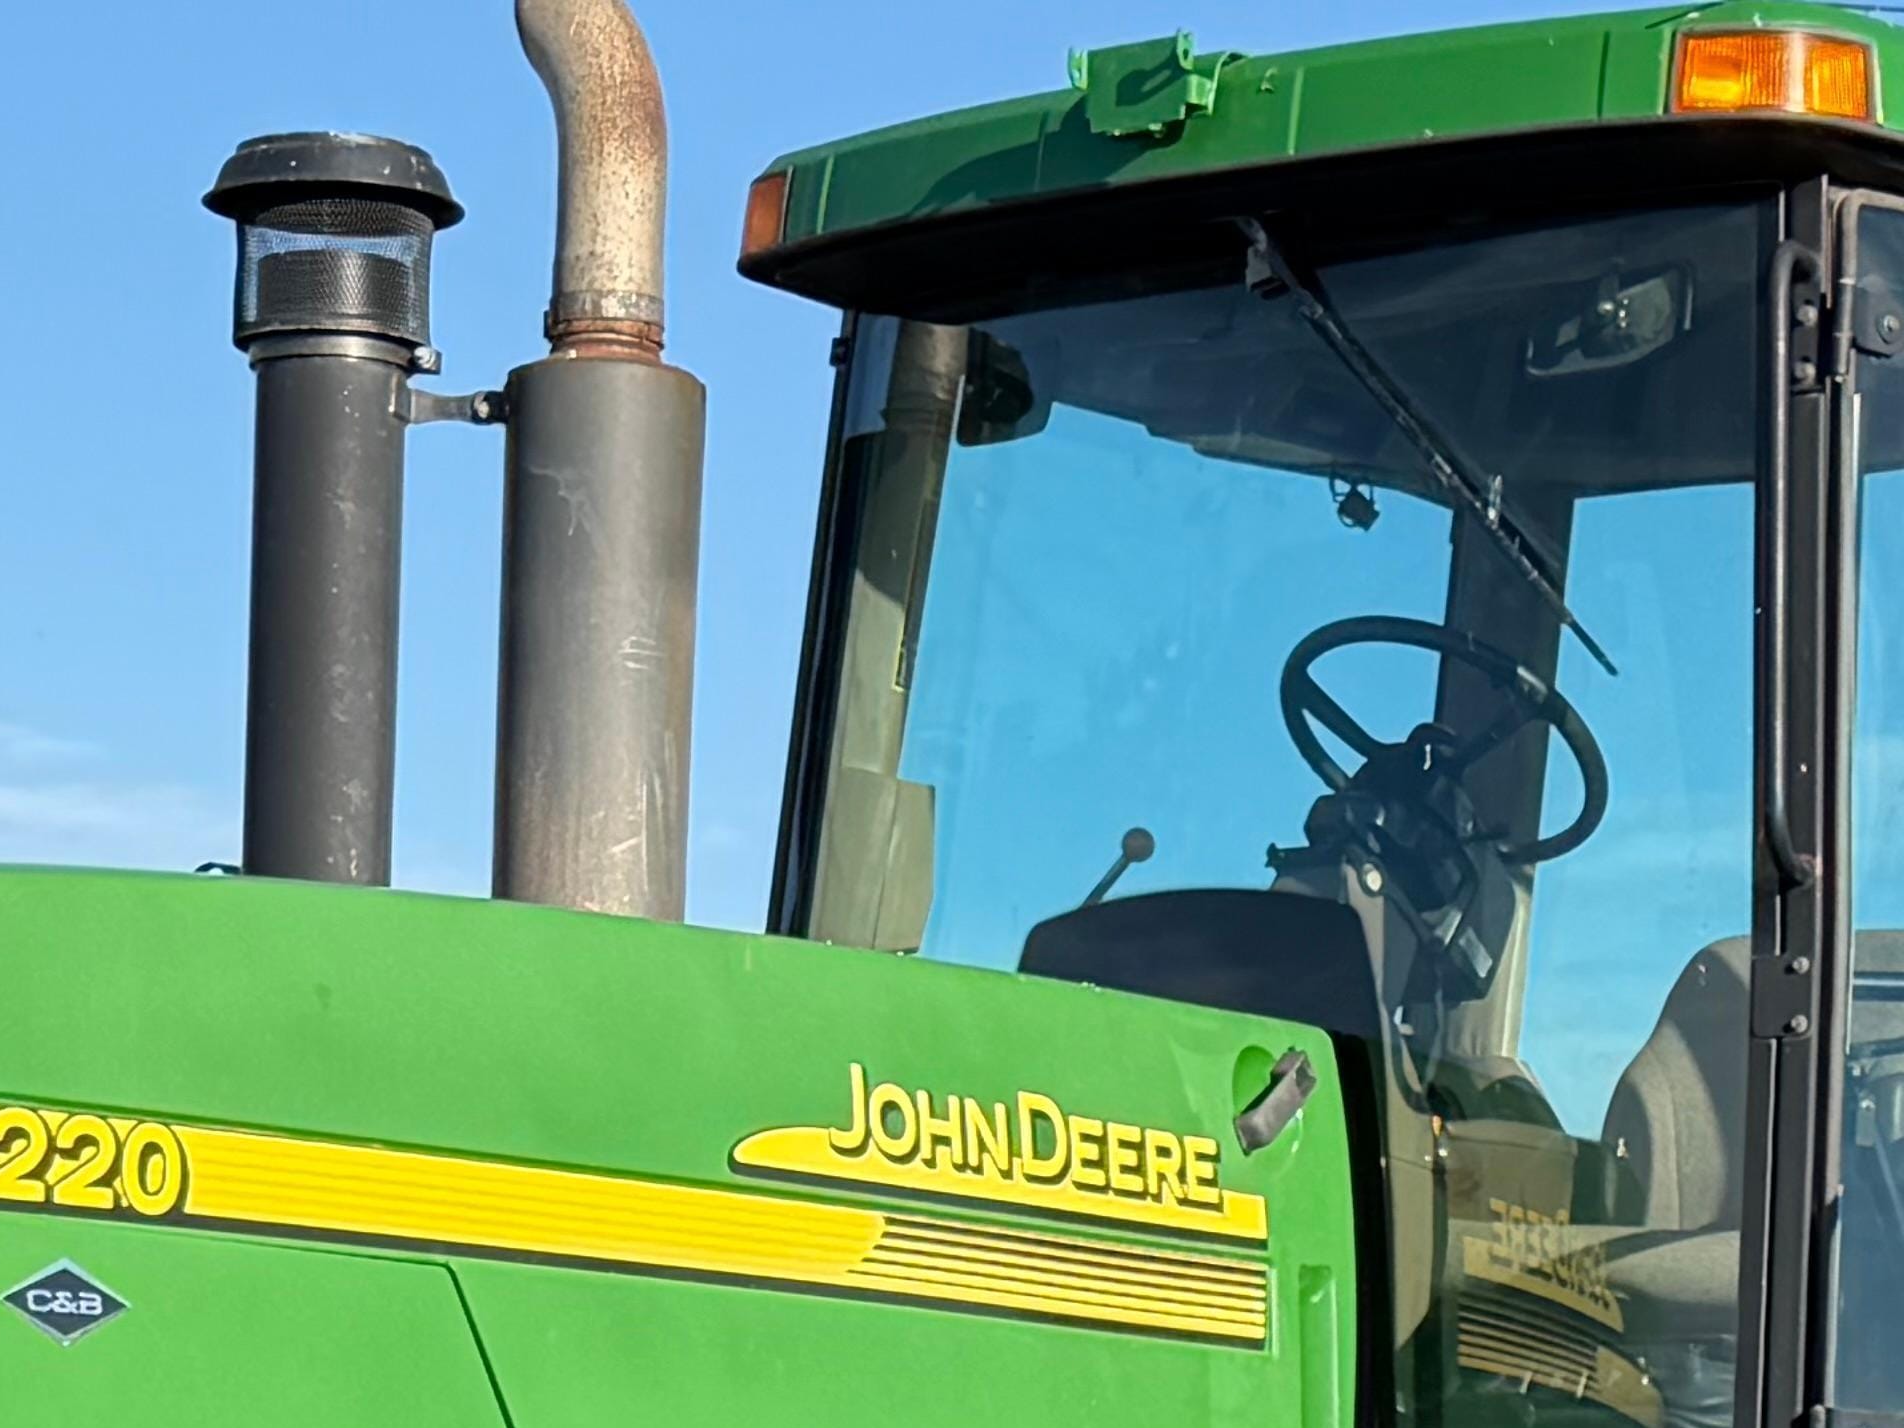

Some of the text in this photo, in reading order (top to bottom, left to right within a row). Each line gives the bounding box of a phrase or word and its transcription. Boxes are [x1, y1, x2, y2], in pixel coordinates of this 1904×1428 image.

[829, 1062, 1224, 1210] JOHN DEERE
[26, 1288, 104, 1316] C&B
